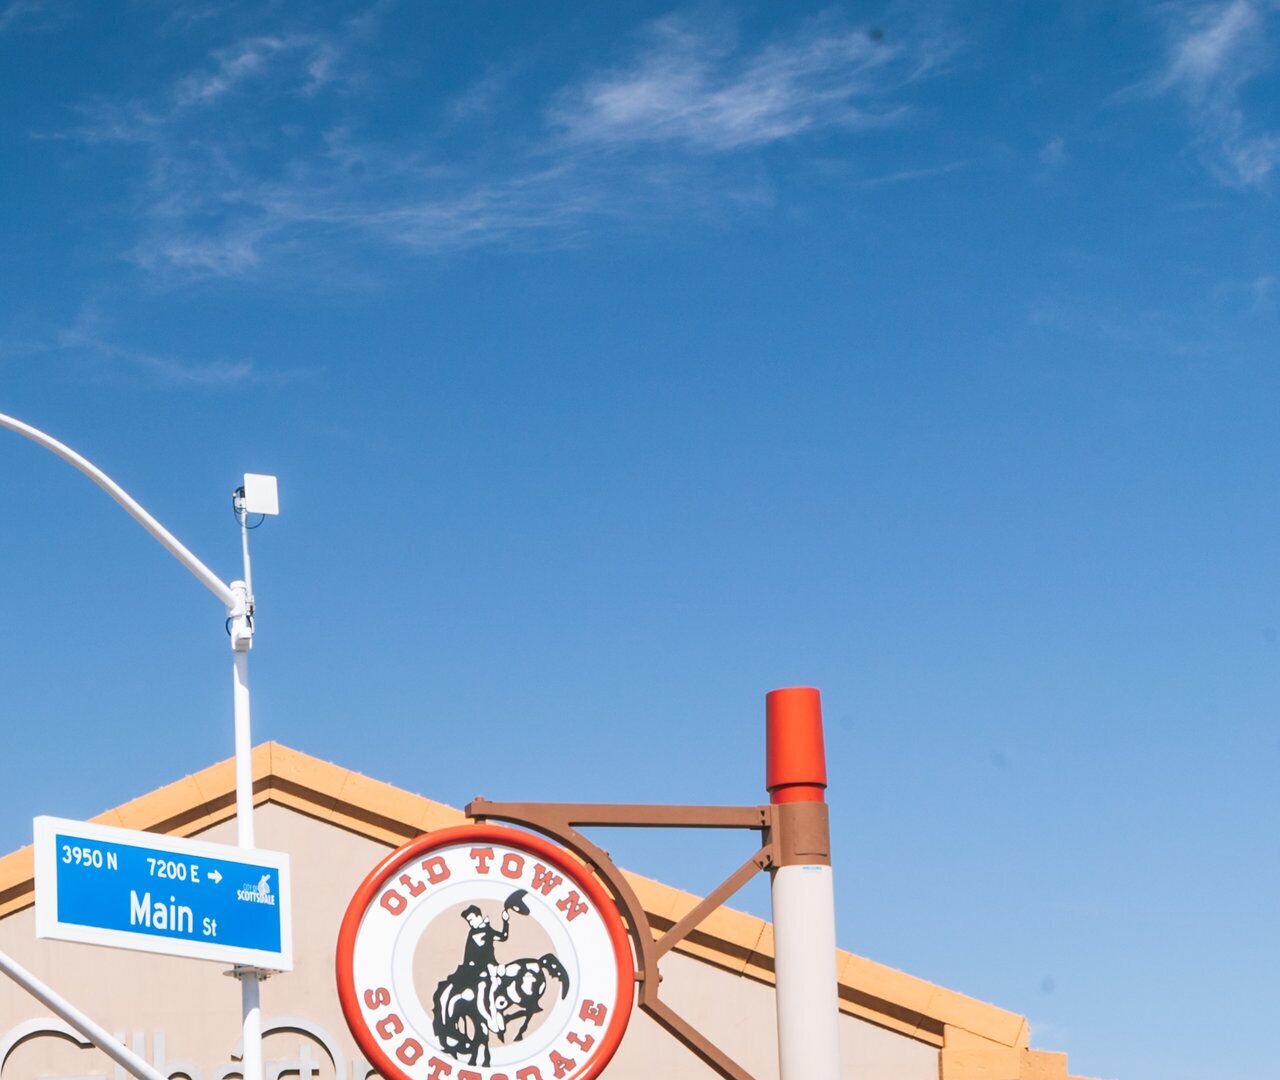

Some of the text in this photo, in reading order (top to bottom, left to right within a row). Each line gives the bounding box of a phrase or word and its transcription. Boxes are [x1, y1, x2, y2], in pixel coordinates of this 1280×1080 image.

[62, 845, 200, 883] 3950 N 7200 E
[380, 847, 589, 922] OLD TOWN
[130, 890, 217, 937] Main St
[236, 889, 276, 906] SCOTTSDALE
